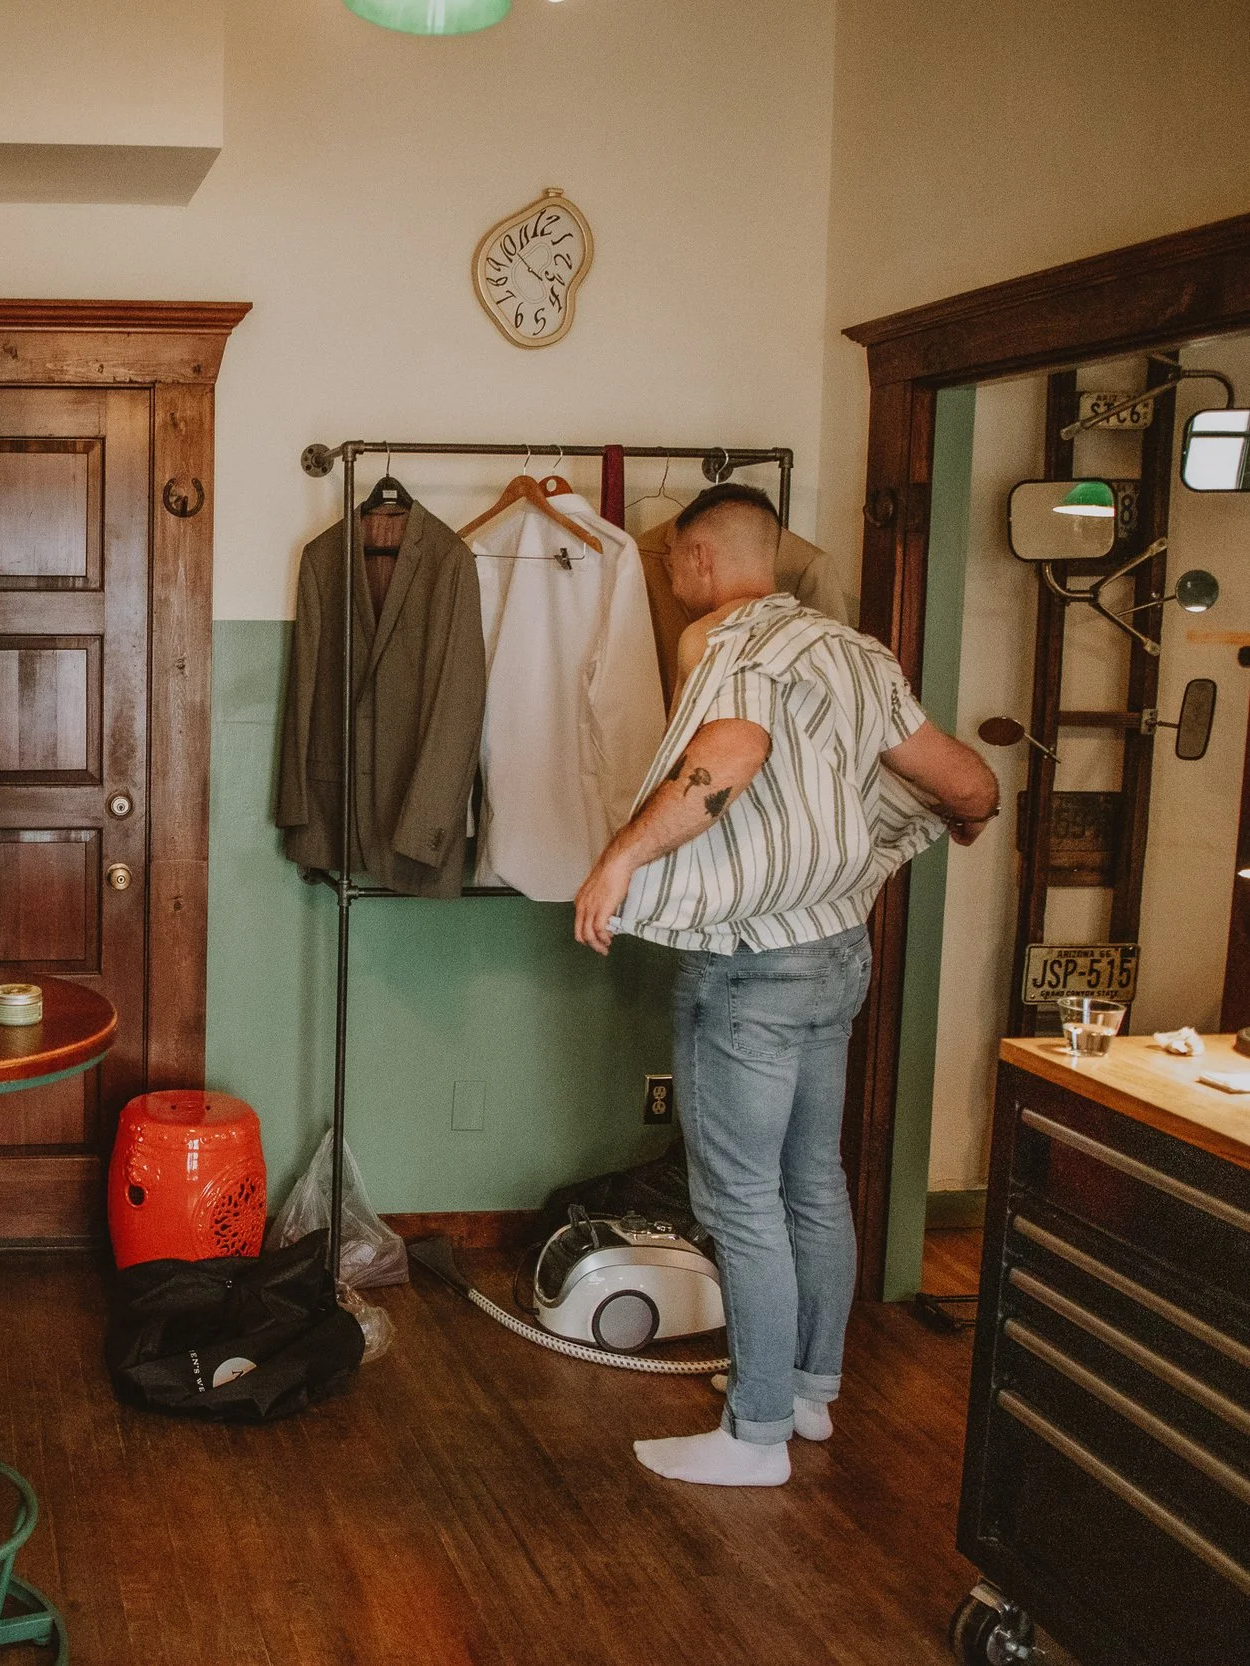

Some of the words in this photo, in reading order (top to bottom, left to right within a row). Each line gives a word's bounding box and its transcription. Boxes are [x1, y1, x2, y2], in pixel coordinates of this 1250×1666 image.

[531, 209, 561, 238] 12
[500, 234, 517, 264] 10
[519, 223, 530, 250] 11
[551, 233, 574, 246] 1
[486, 257, 510, 272] 9
[553, 253, 573, 270] 2
[486, 276, 508, 287] 8
[545, 270, 566, 287] 3
[496, 290, 517, 305] 7
[549, 285, 562, 313] 4
[514, 302, 524, 329] 6
[532, 307, 547, 336] 5
[1057, 950, 1095, 958] ARIZONA
[1032, 958, 1132, 988] JSP-515
[189, 1349, 200, 1374] EN'S
